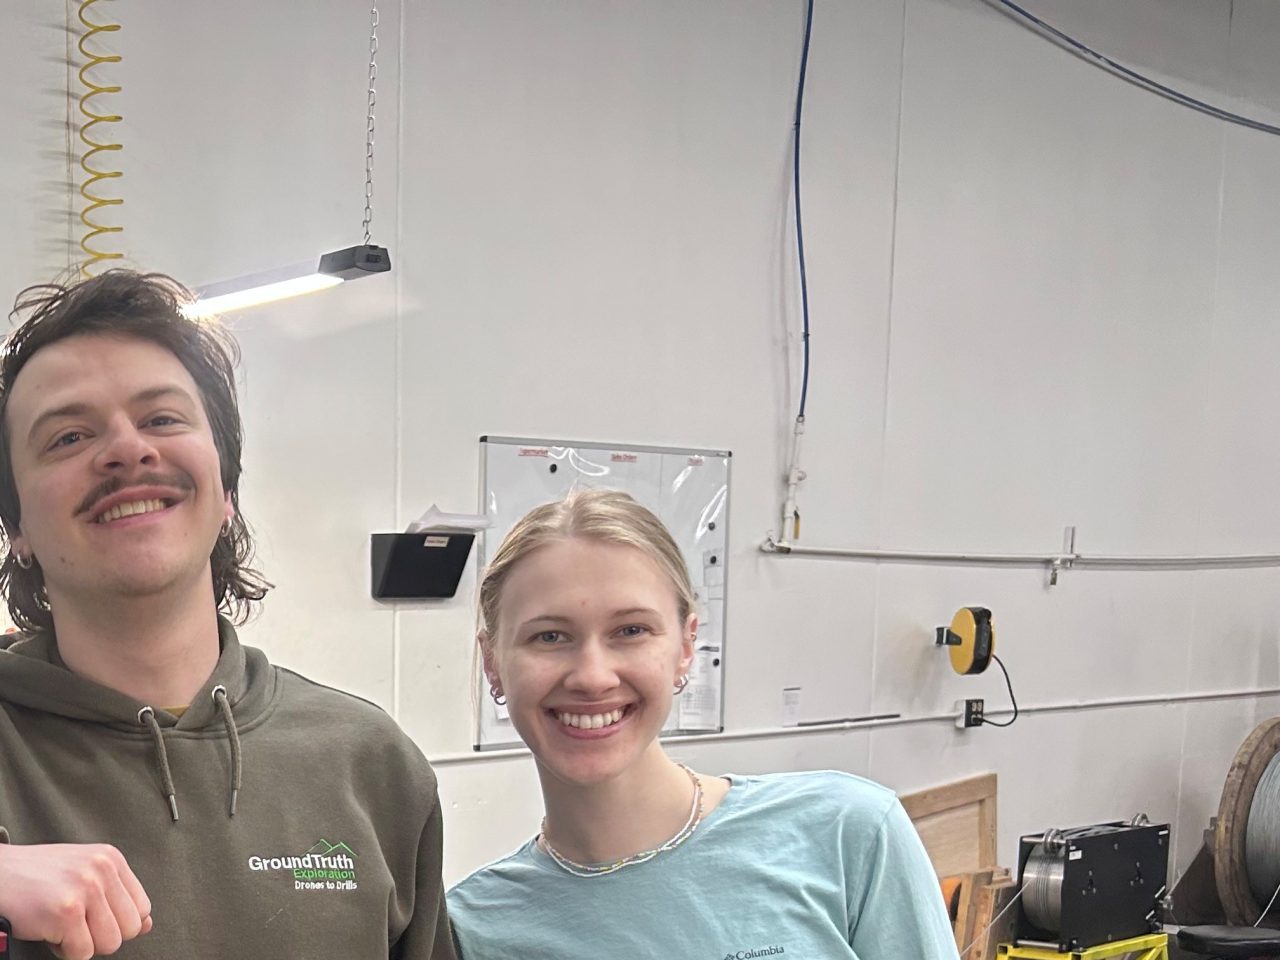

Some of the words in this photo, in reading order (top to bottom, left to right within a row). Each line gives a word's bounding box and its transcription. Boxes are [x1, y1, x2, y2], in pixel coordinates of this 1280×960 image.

[248, 853, 354, 871] GroundTruth
[293, 868, 356, 881] Exploration
[295, 880, 324, 890] Drones
[326, 881, 335, 890] to
[336, 880, 358, 890] Drills
[735, 945, 785, 960] Columbia
